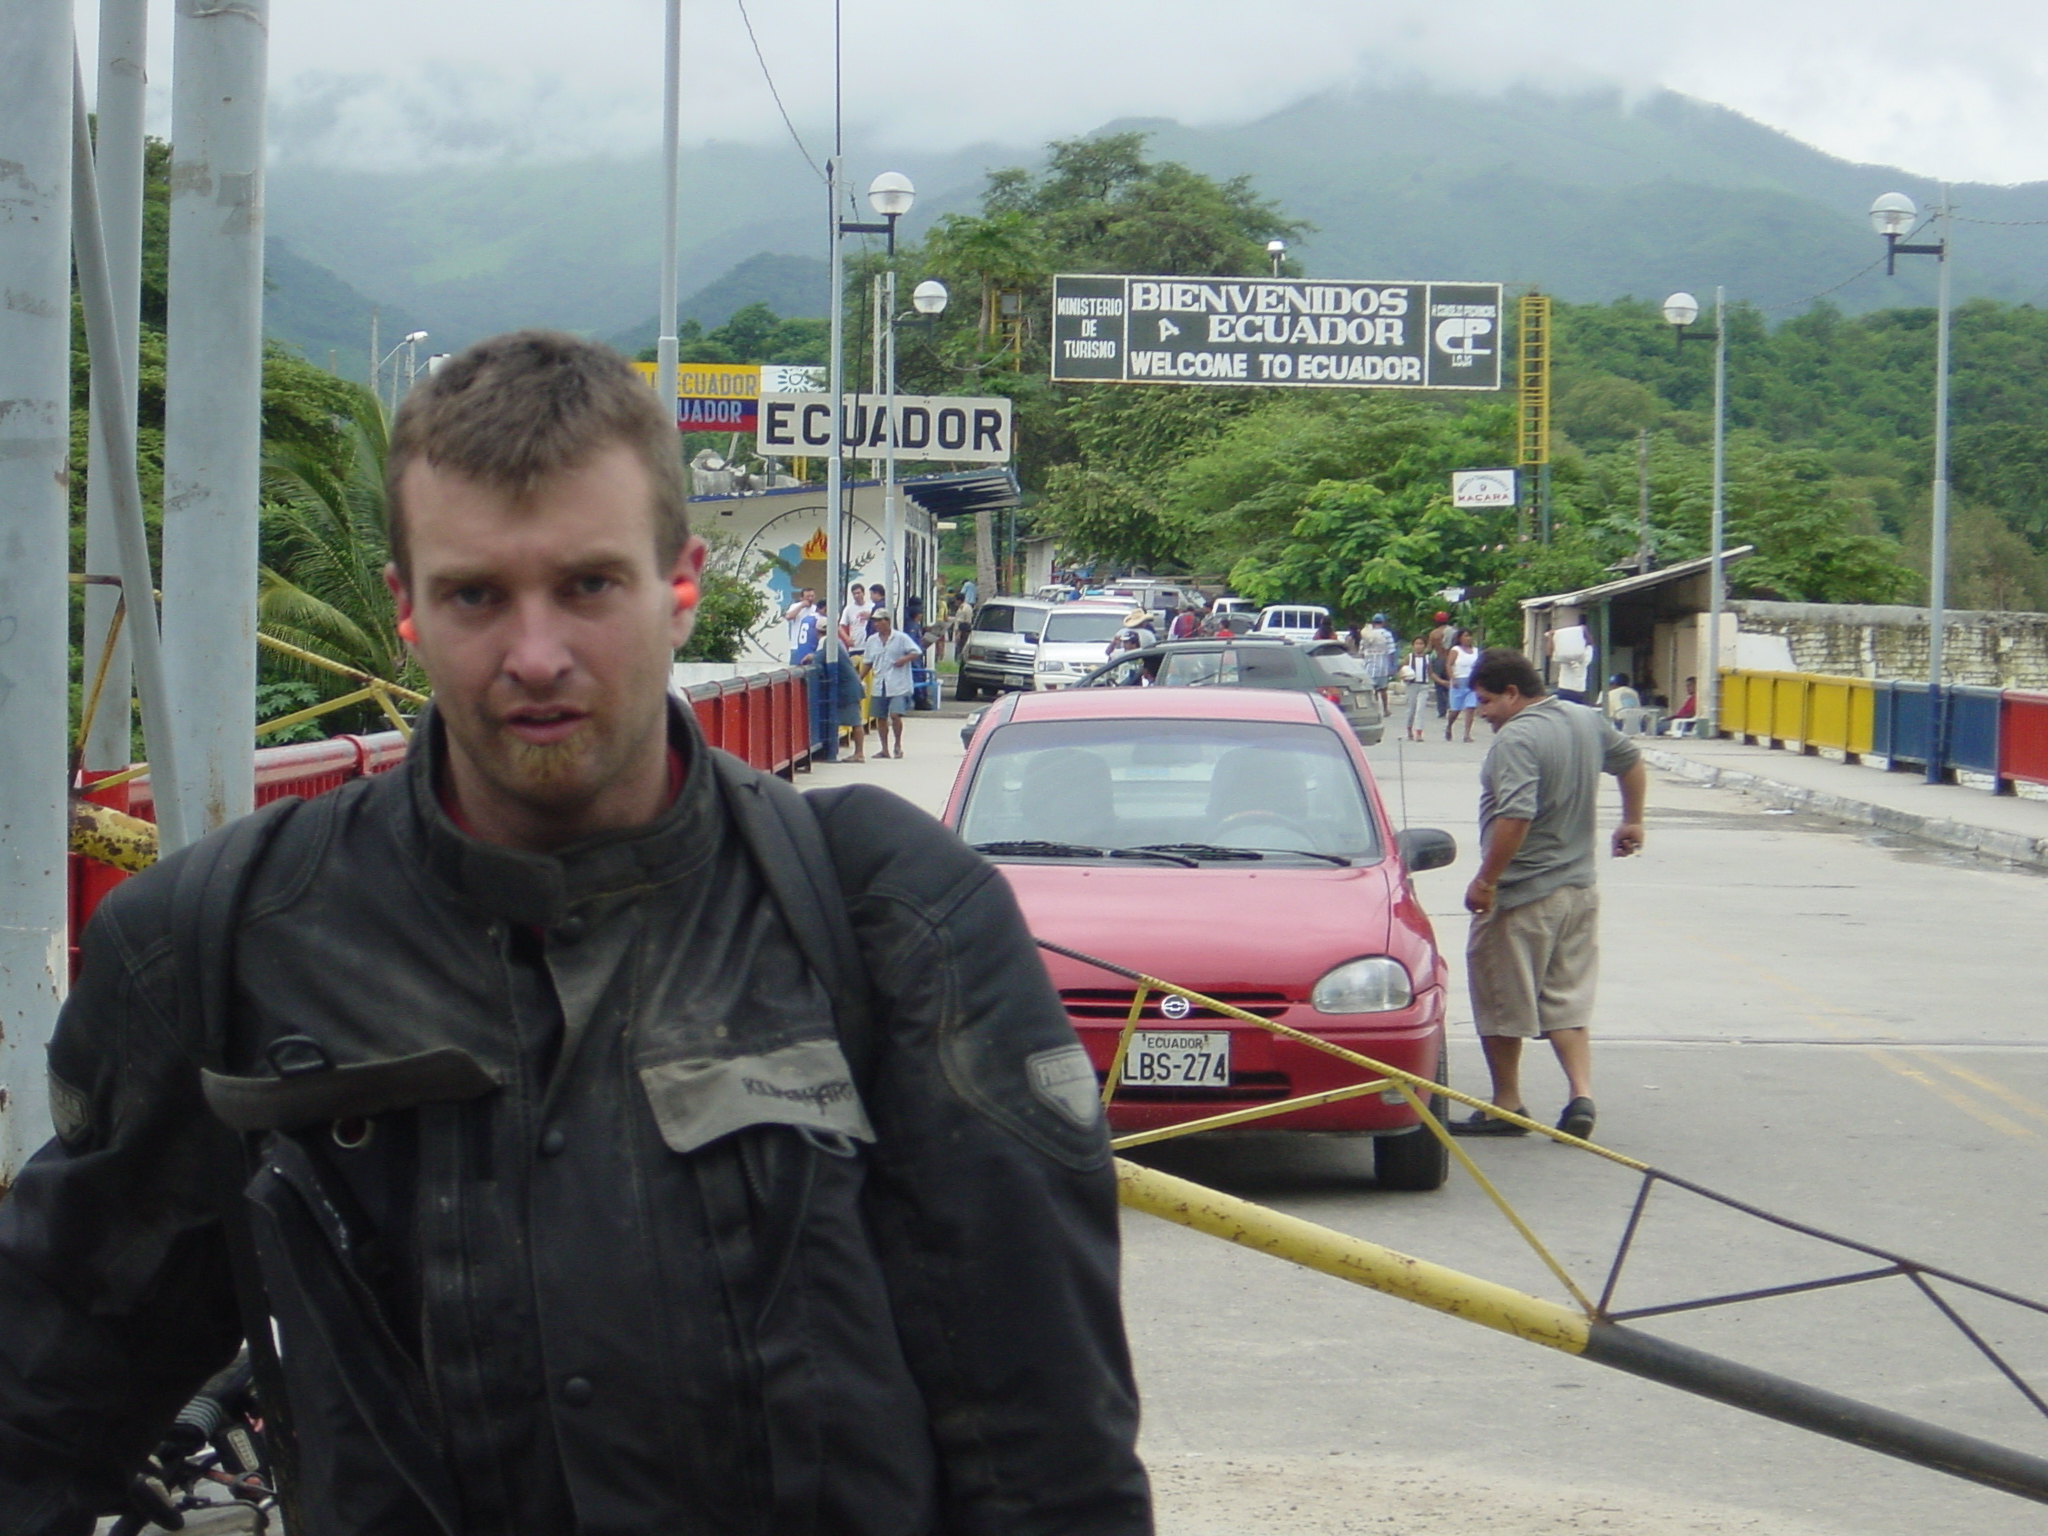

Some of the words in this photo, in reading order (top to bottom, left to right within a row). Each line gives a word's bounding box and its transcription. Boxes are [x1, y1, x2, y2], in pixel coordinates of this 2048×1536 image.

[1057, 297, 1123, 316] MINISTERIO
[1131, 283, 1408, 315] BIENVENIDOS
[1081, 319, 1098, 337] DE
[1158, 317, 1180, 342] A
[1208, 315, 1404, 345] ECUADOR
[1063, 340, 1116, 358] TURISMO
[1131, 351, 1247, 378] WELCOME
[1259, 354, 1292, 378] TO
[1298, 355, 1420, 381] ECUADOR
[678, 399, 742, 423] UADOR
[766, 403, 1003, 452] ECUADOR
[1147, 1037, 1203, 1050] ECUADOR
[1123, 1053, 1226, 1081] LBS-274
